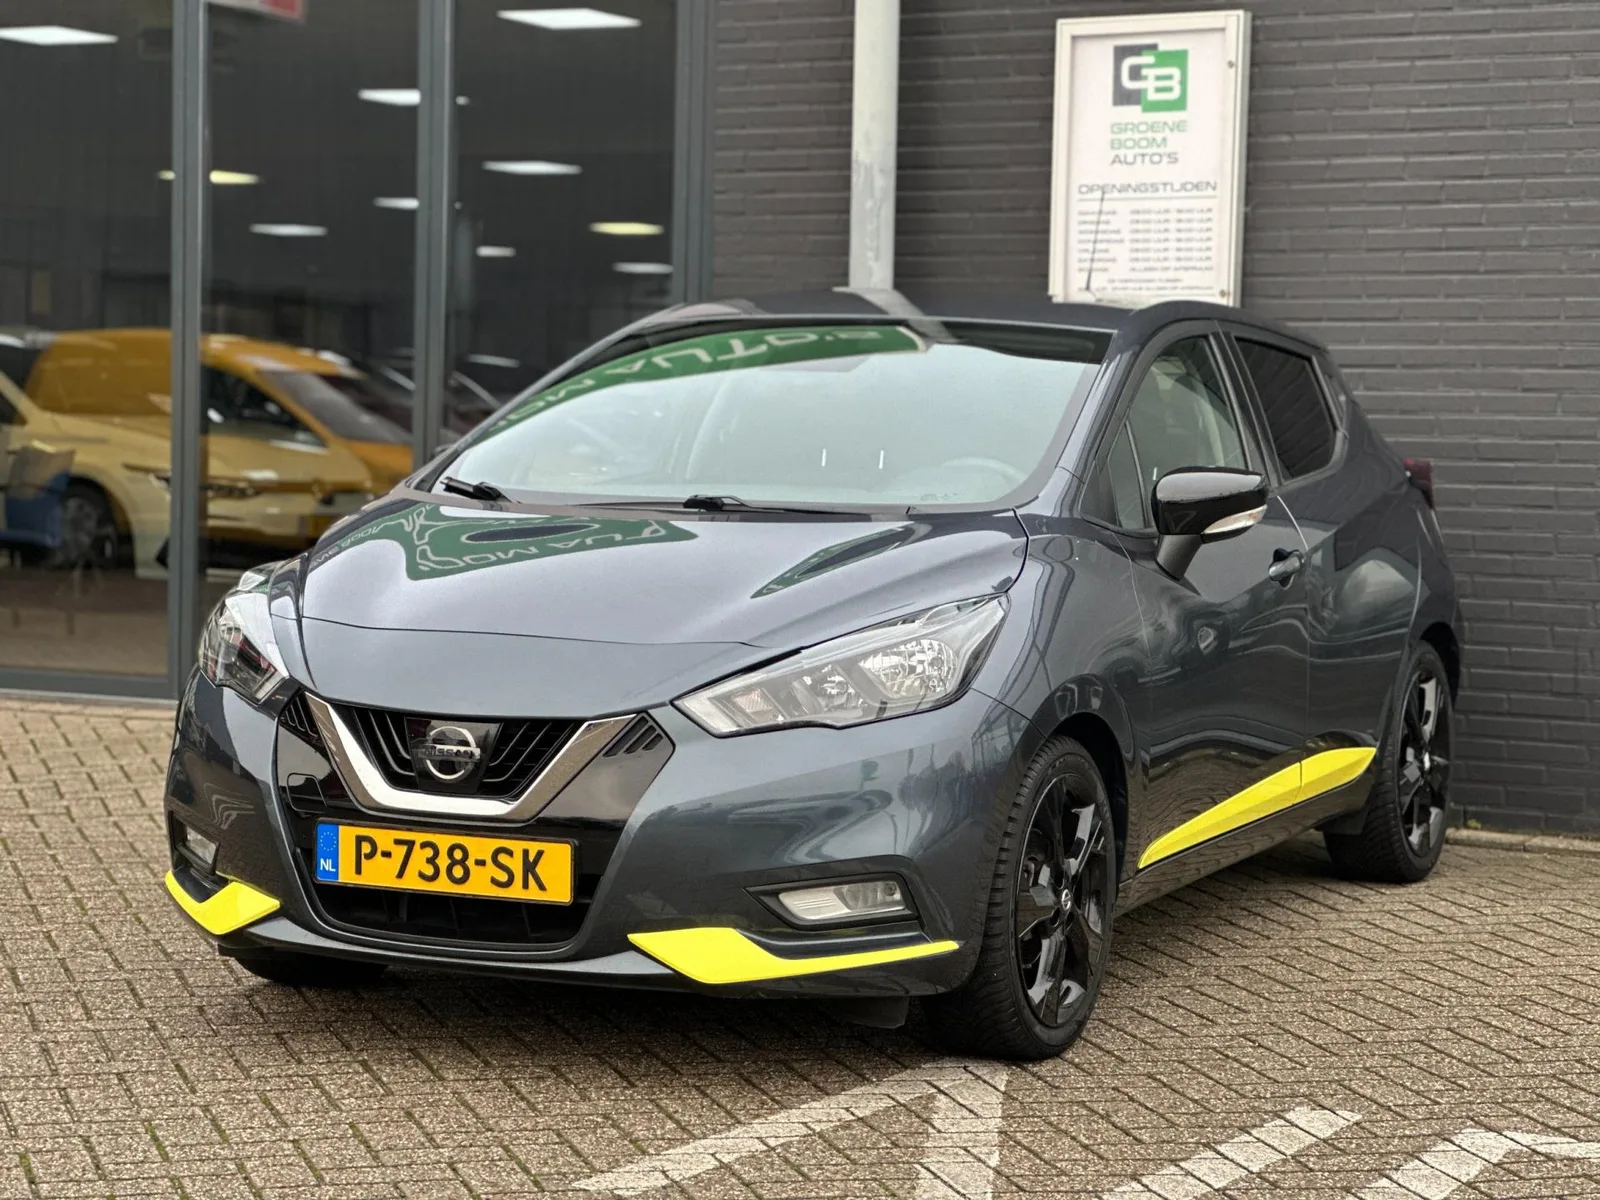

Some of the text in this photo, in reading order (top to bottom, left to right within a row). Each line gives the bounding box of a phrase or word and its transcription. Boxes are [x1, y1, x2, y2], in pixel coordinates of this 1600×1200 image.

[1110, 119, 1188, 135] GROENE
[1109, 136, 1168, 150] BOOM
[1109, 152, 1179, 166] AUTO'S
[320, 858, 336, 872] NL
[354, 834, 547, 893] P-738-SK
